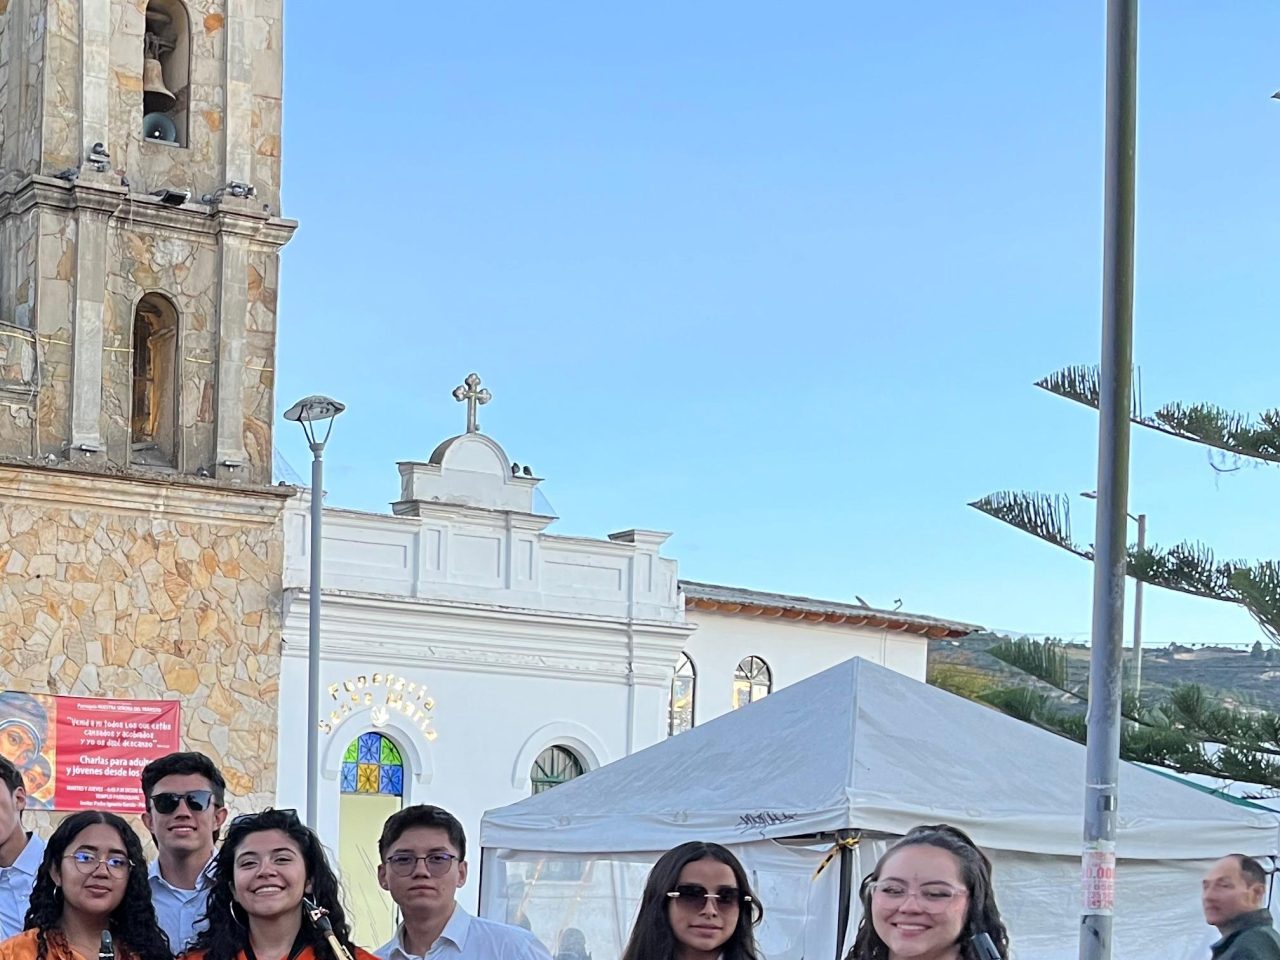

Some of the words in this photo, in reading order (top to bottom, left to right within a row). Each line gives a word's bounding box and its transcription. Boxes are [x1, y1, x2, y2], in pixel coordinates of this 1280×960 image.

[328, 673, 435, 711] Funeraria
[80, 755, 109, 765] Charlas
[109, 757, 128, 767] para
[66, 766, 72, 776] y
[72, 765, 103, 776] jóvenes
[104, 766, 128, 777] desde
[128, 767, 140, 777] los
